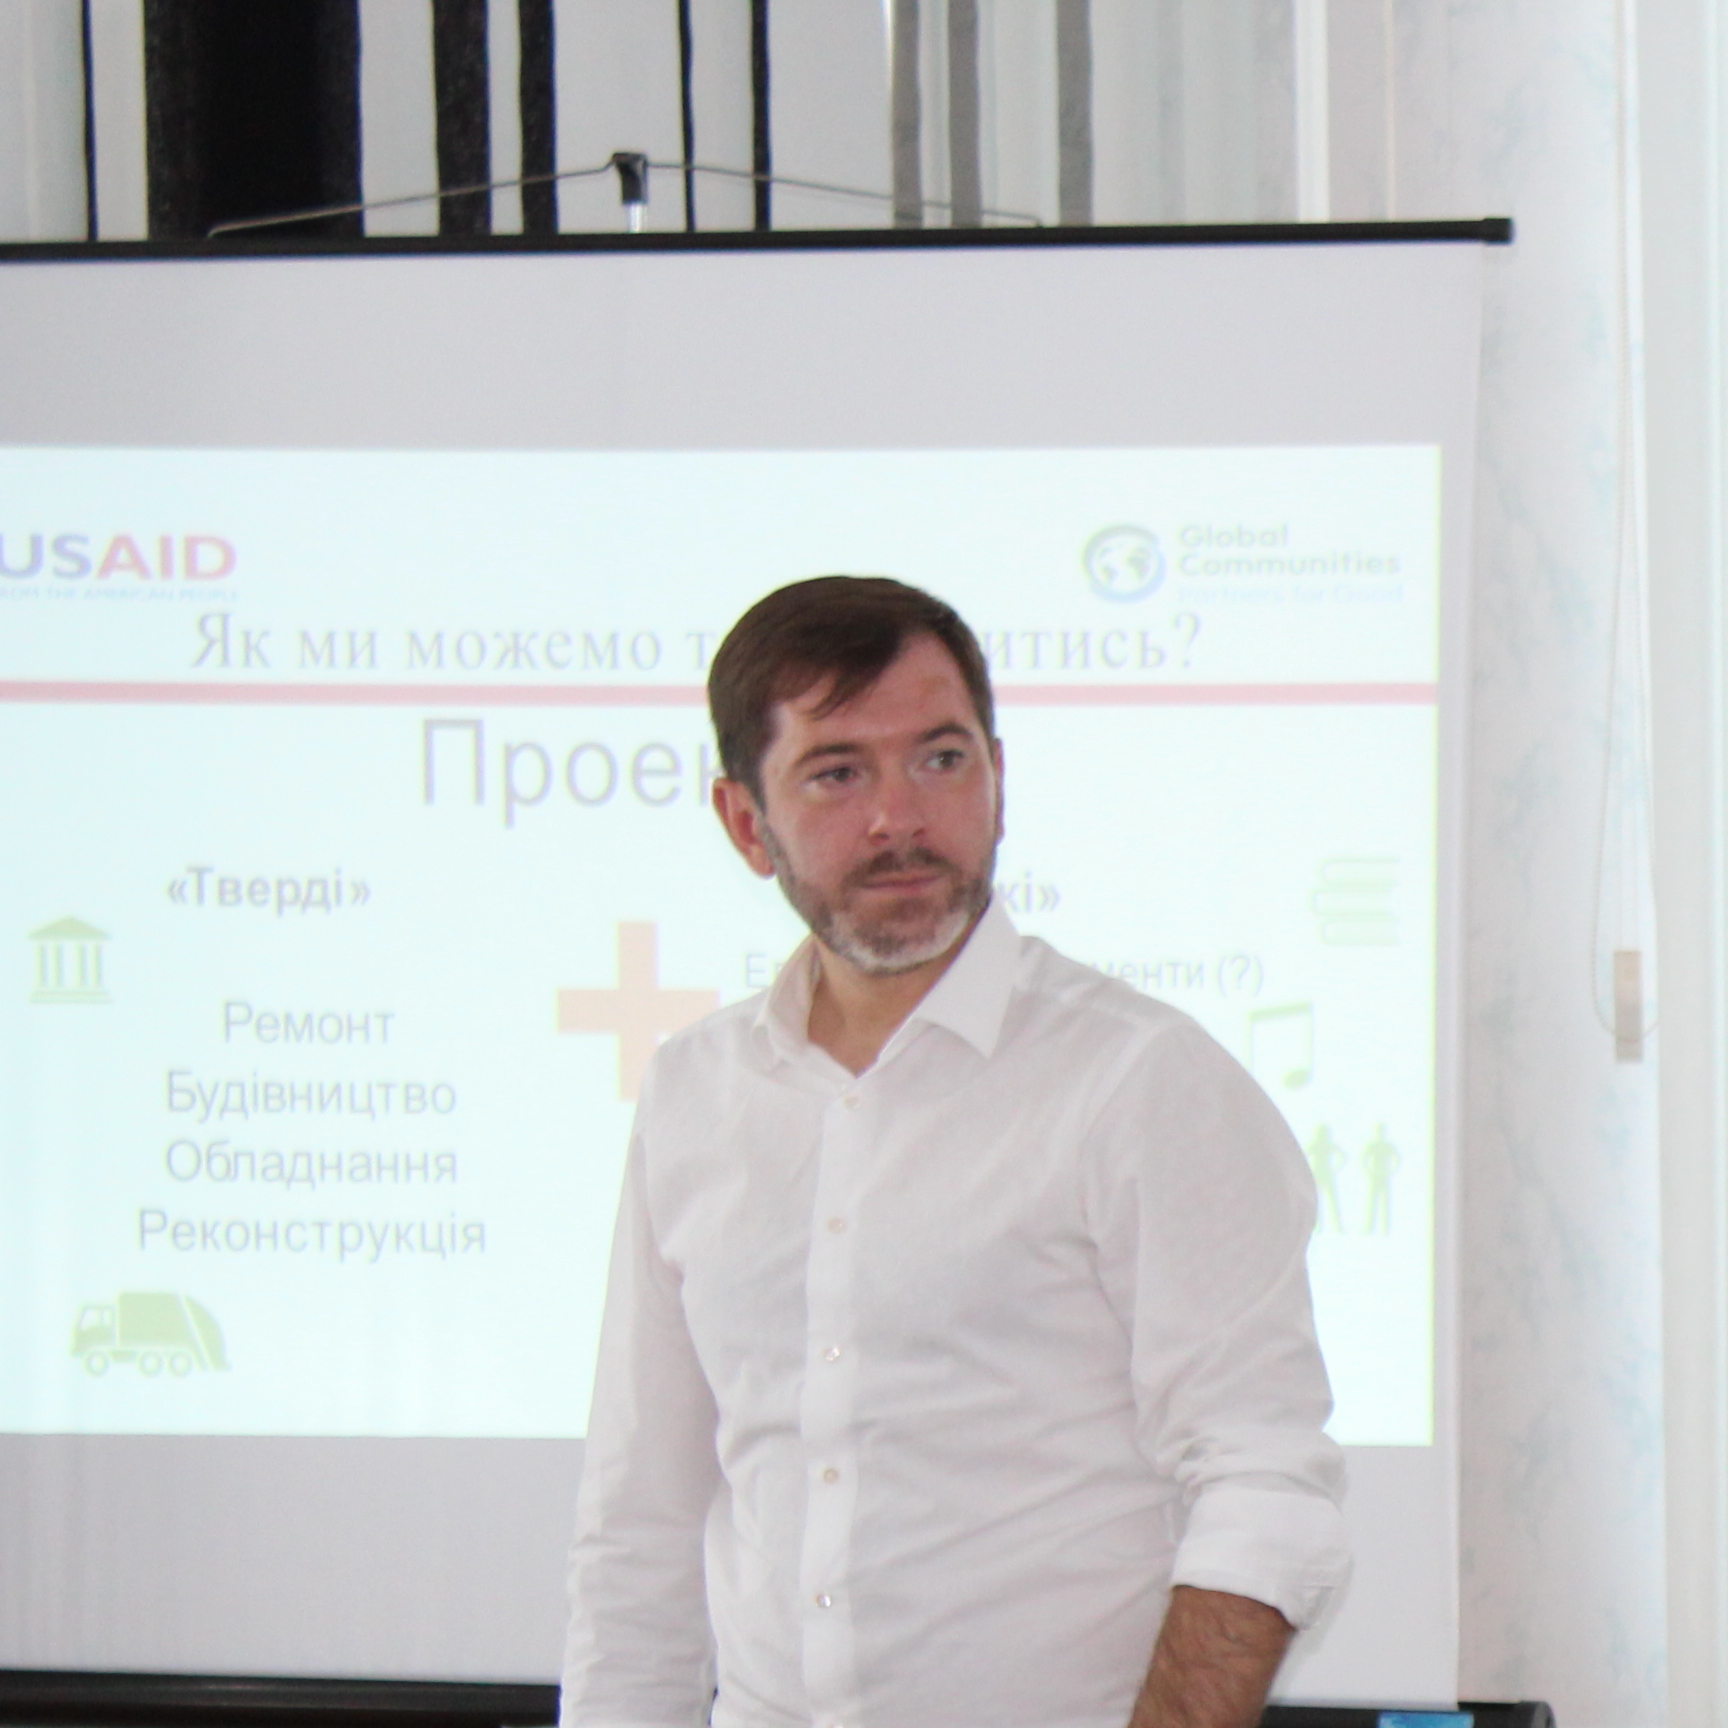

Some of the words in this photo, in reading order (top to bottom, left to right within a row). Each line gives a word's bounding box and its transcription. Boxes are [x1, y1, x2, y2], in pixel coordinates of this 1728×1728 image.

[0, 533, 239, 582] USAID
[1179, 523, 1288, 547] Global
[1179, 552, 1400, 576] Communities
[189, 611, 273, 670] Як
[297, 628, 380, 670] ми
[405, 628, 664, 671] можемо
[165, 862, 371, 917] «Тверді»
[222, 998, 396, 1045] Ремонт
[165, 1066, 458, 1124] Будівництво
[164, 1136, 458, 1191] Обладнання
[137, 1206, 486, 1264] Реконструкція
